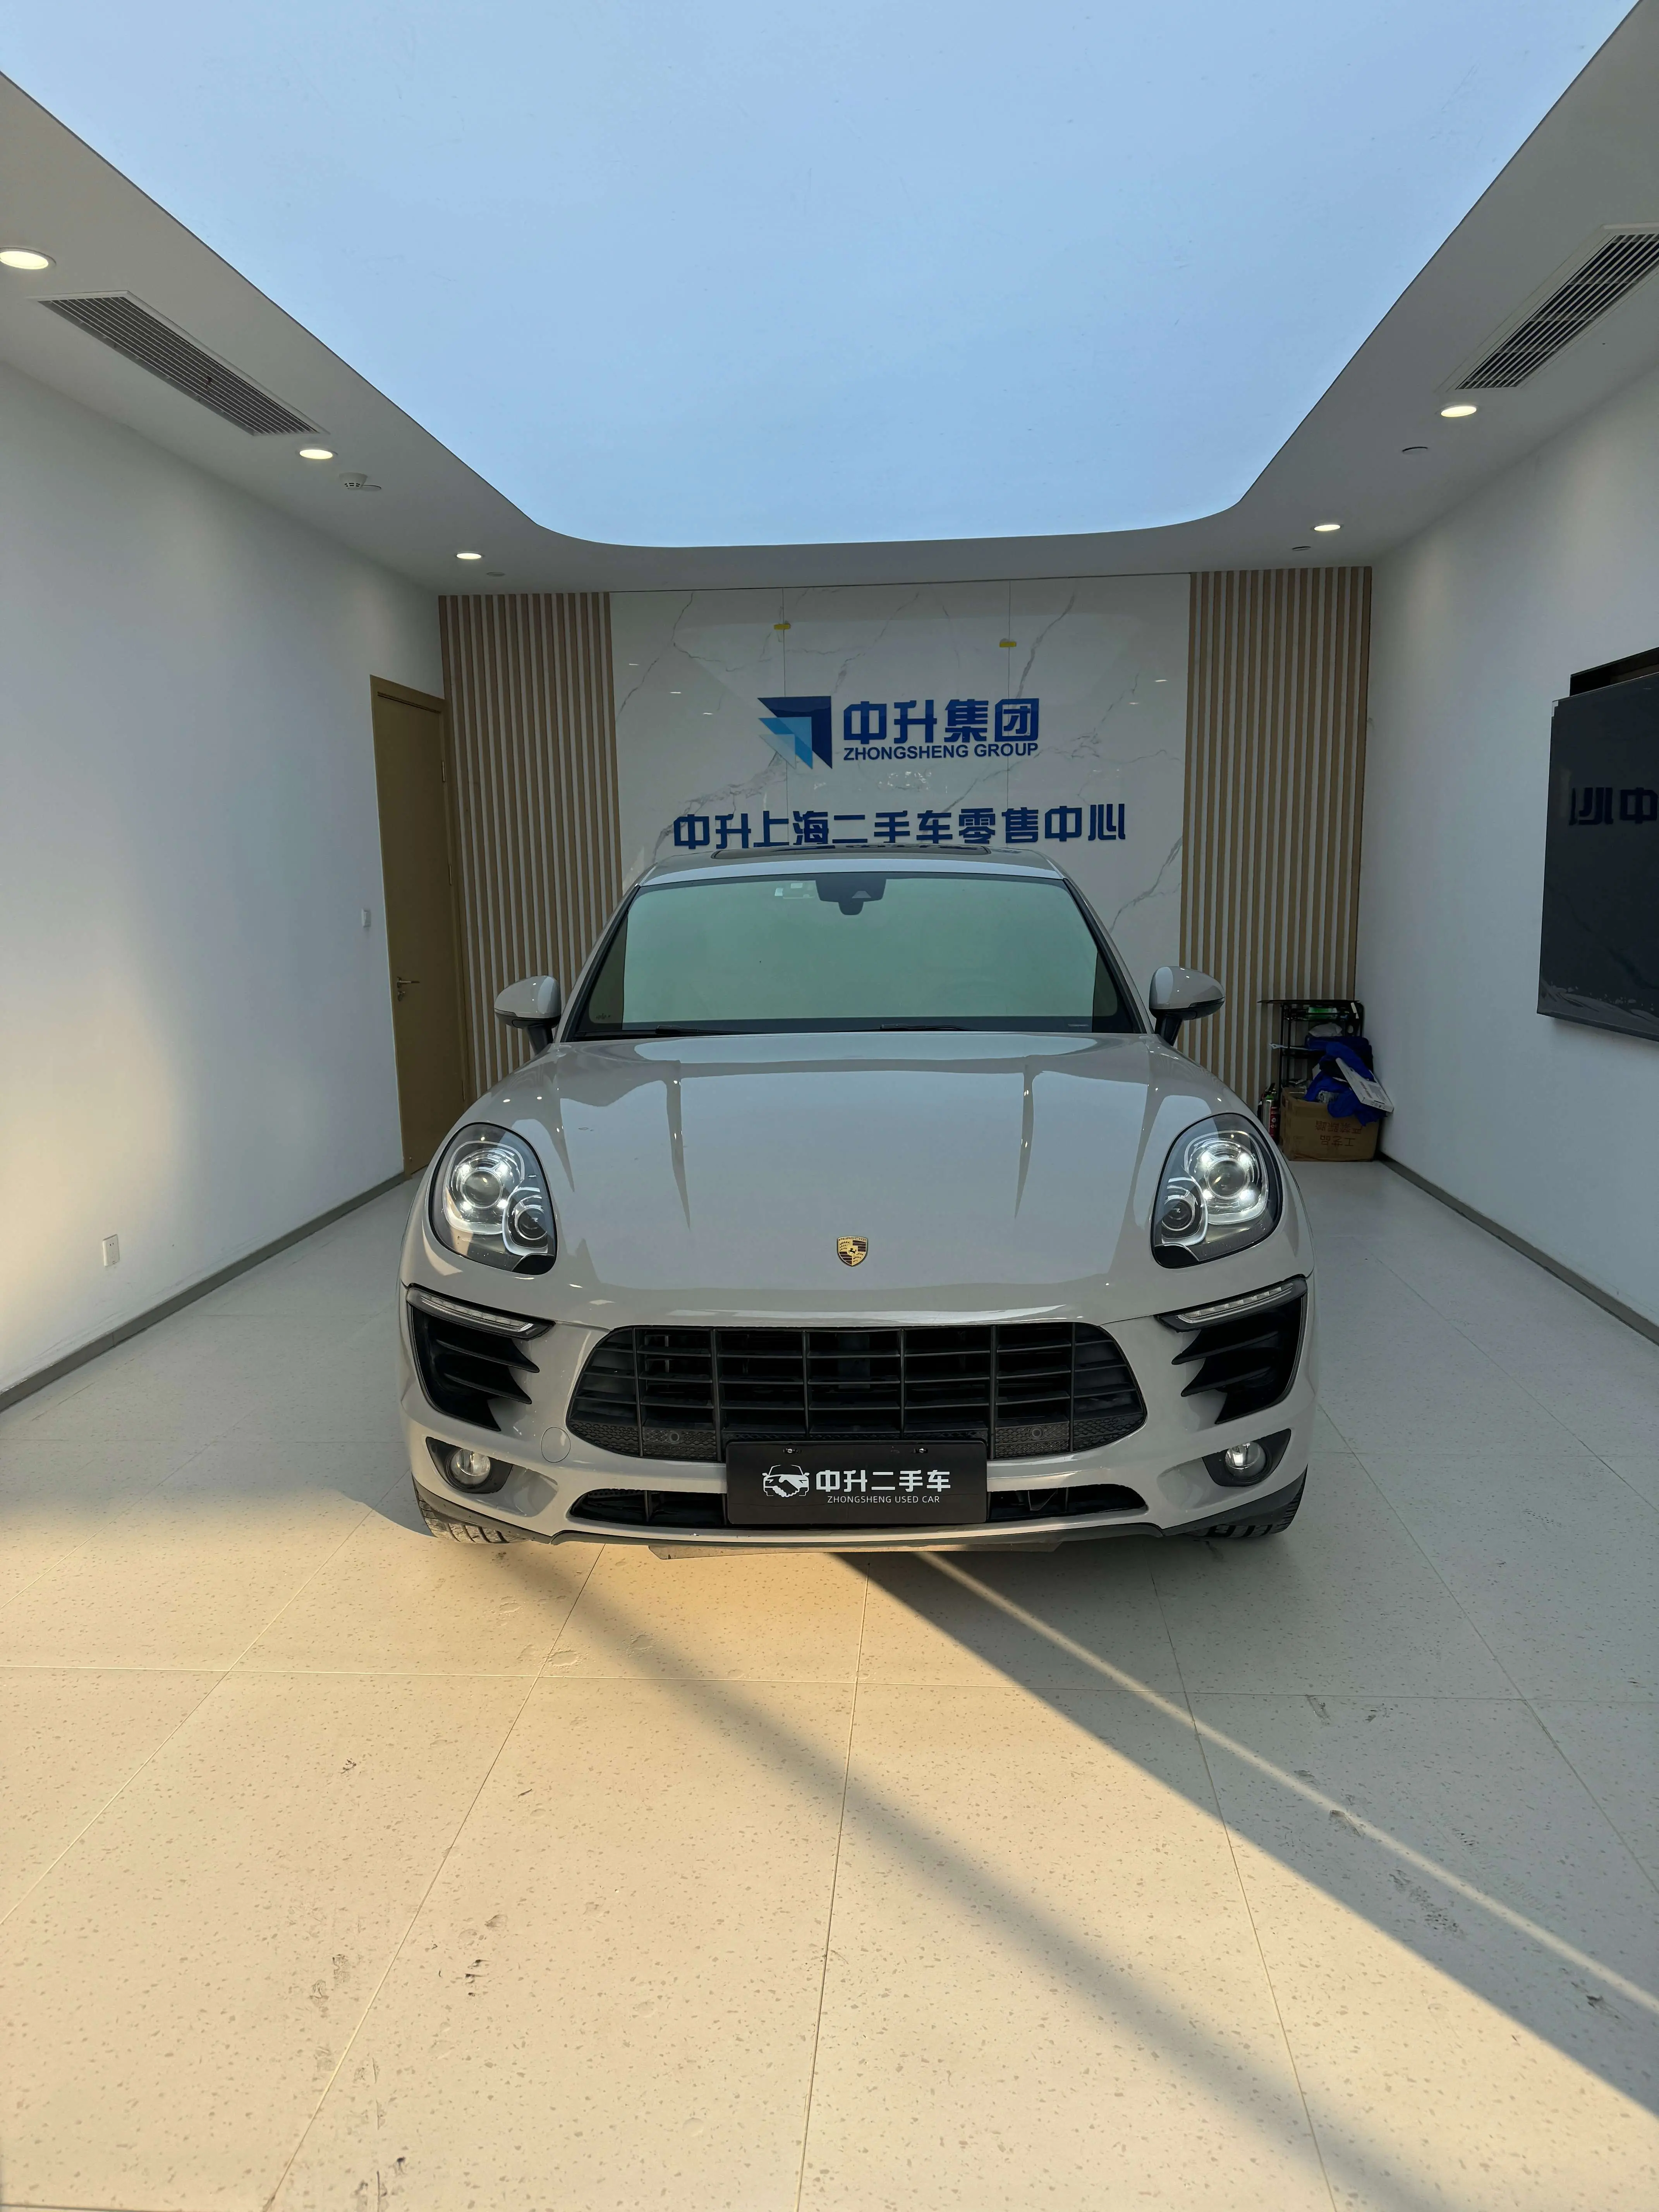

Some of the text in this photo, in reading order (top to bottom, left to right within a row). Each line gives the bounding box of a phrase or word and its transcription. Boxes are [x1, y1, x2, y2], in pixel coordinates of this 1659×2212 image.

[843, 698, 1039, 744] 中升集团
[843, 742, 1039, 761] ZHONGSHENG GROUP
[674, 804, 1125, 849] 中升上海二手车零售中心
[816, 1470, 951, 1492] 中升二手车
